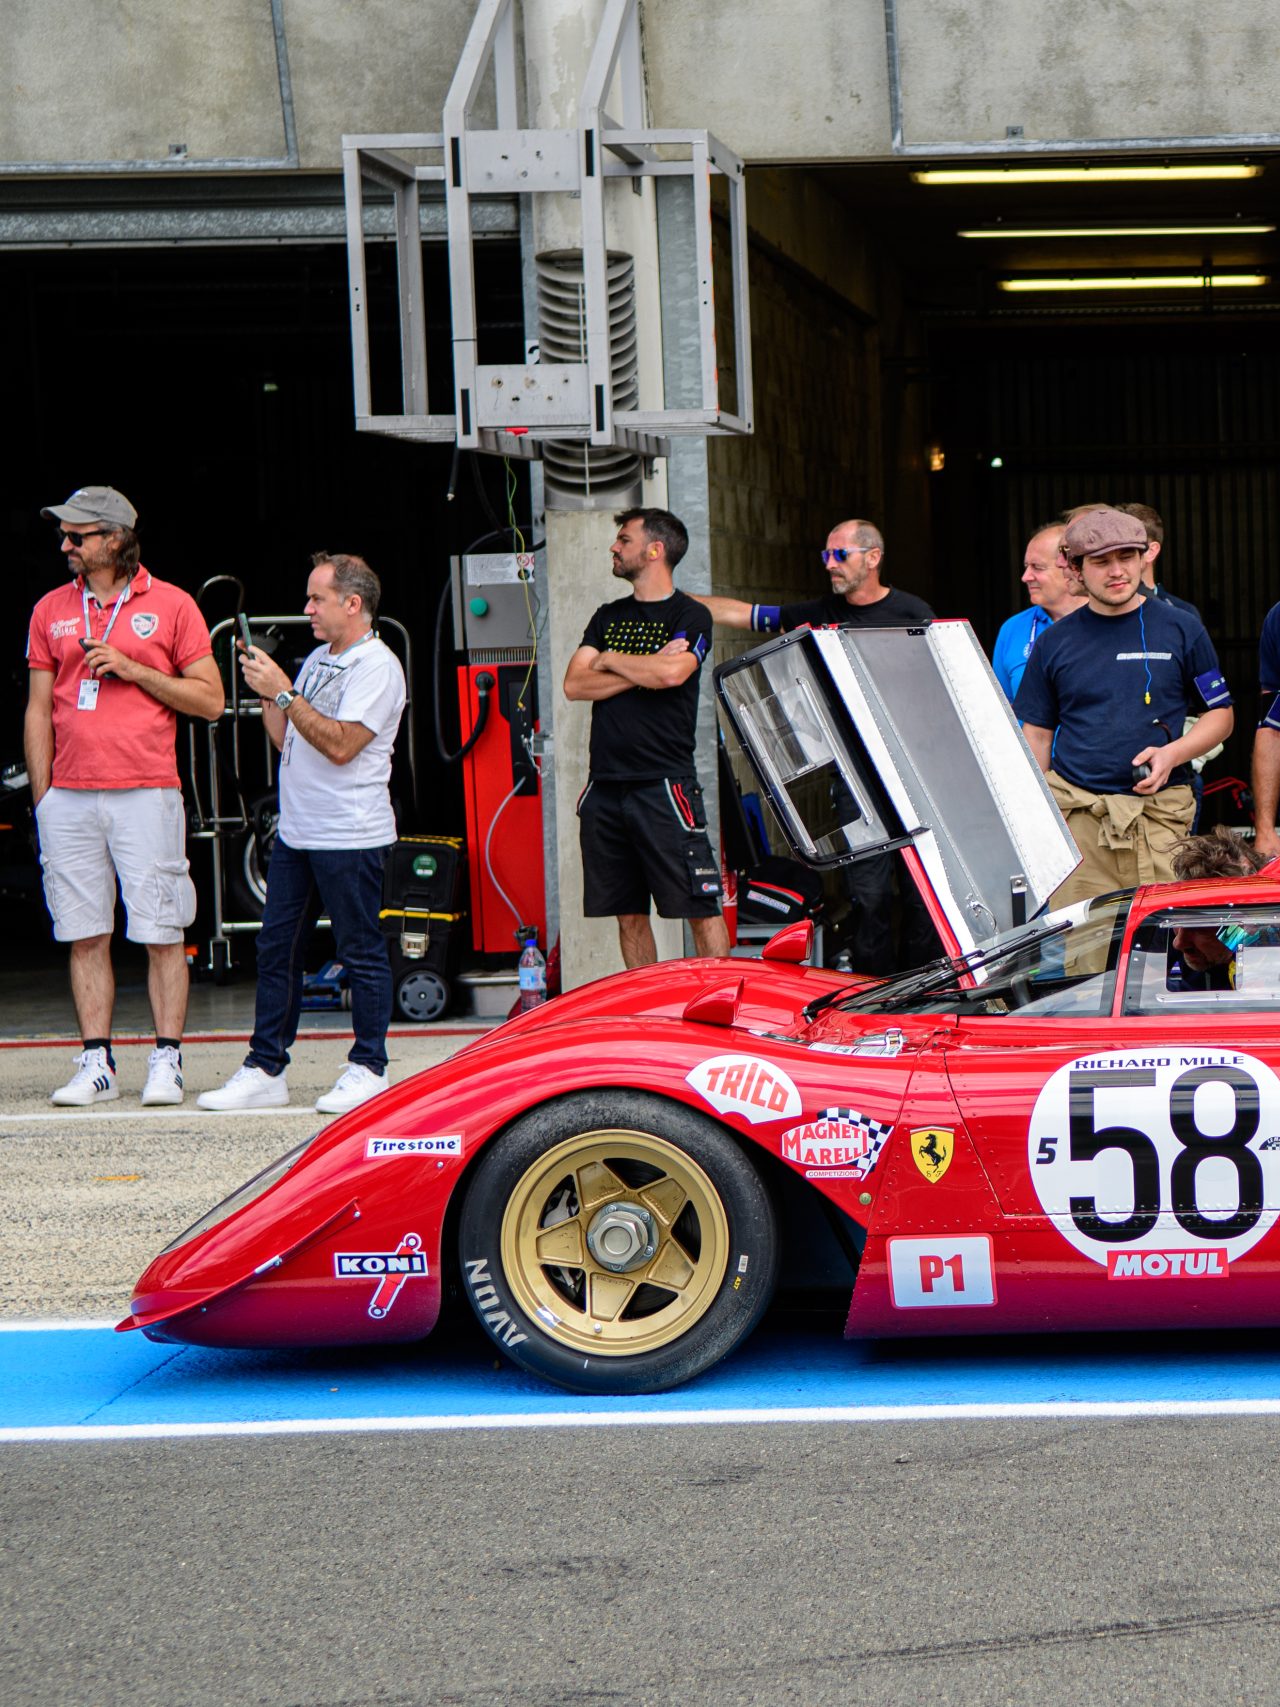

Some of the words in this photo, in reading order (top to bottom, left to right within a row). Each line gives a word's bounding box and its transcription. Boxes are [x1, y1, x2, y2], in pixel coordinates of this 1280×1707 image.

[1075, 1058, 1171, 1070] RICHARD
[1180, 1055, 1245, 1066] MILLE
[706, 1062, 789, 1113] TRICO
[372, 1140, 456, 1153] Firestone
[1036, 1137, 1058, 1164] 5
[1069, 1065, 1264, 1243] 58
[341, 1257, 422, 1273] KONI
[919, 1254, 965, 1292] P1
[1113, 1252, 1223, 1276] MOTUL
[465, 1258, 529, 1347] AVON
